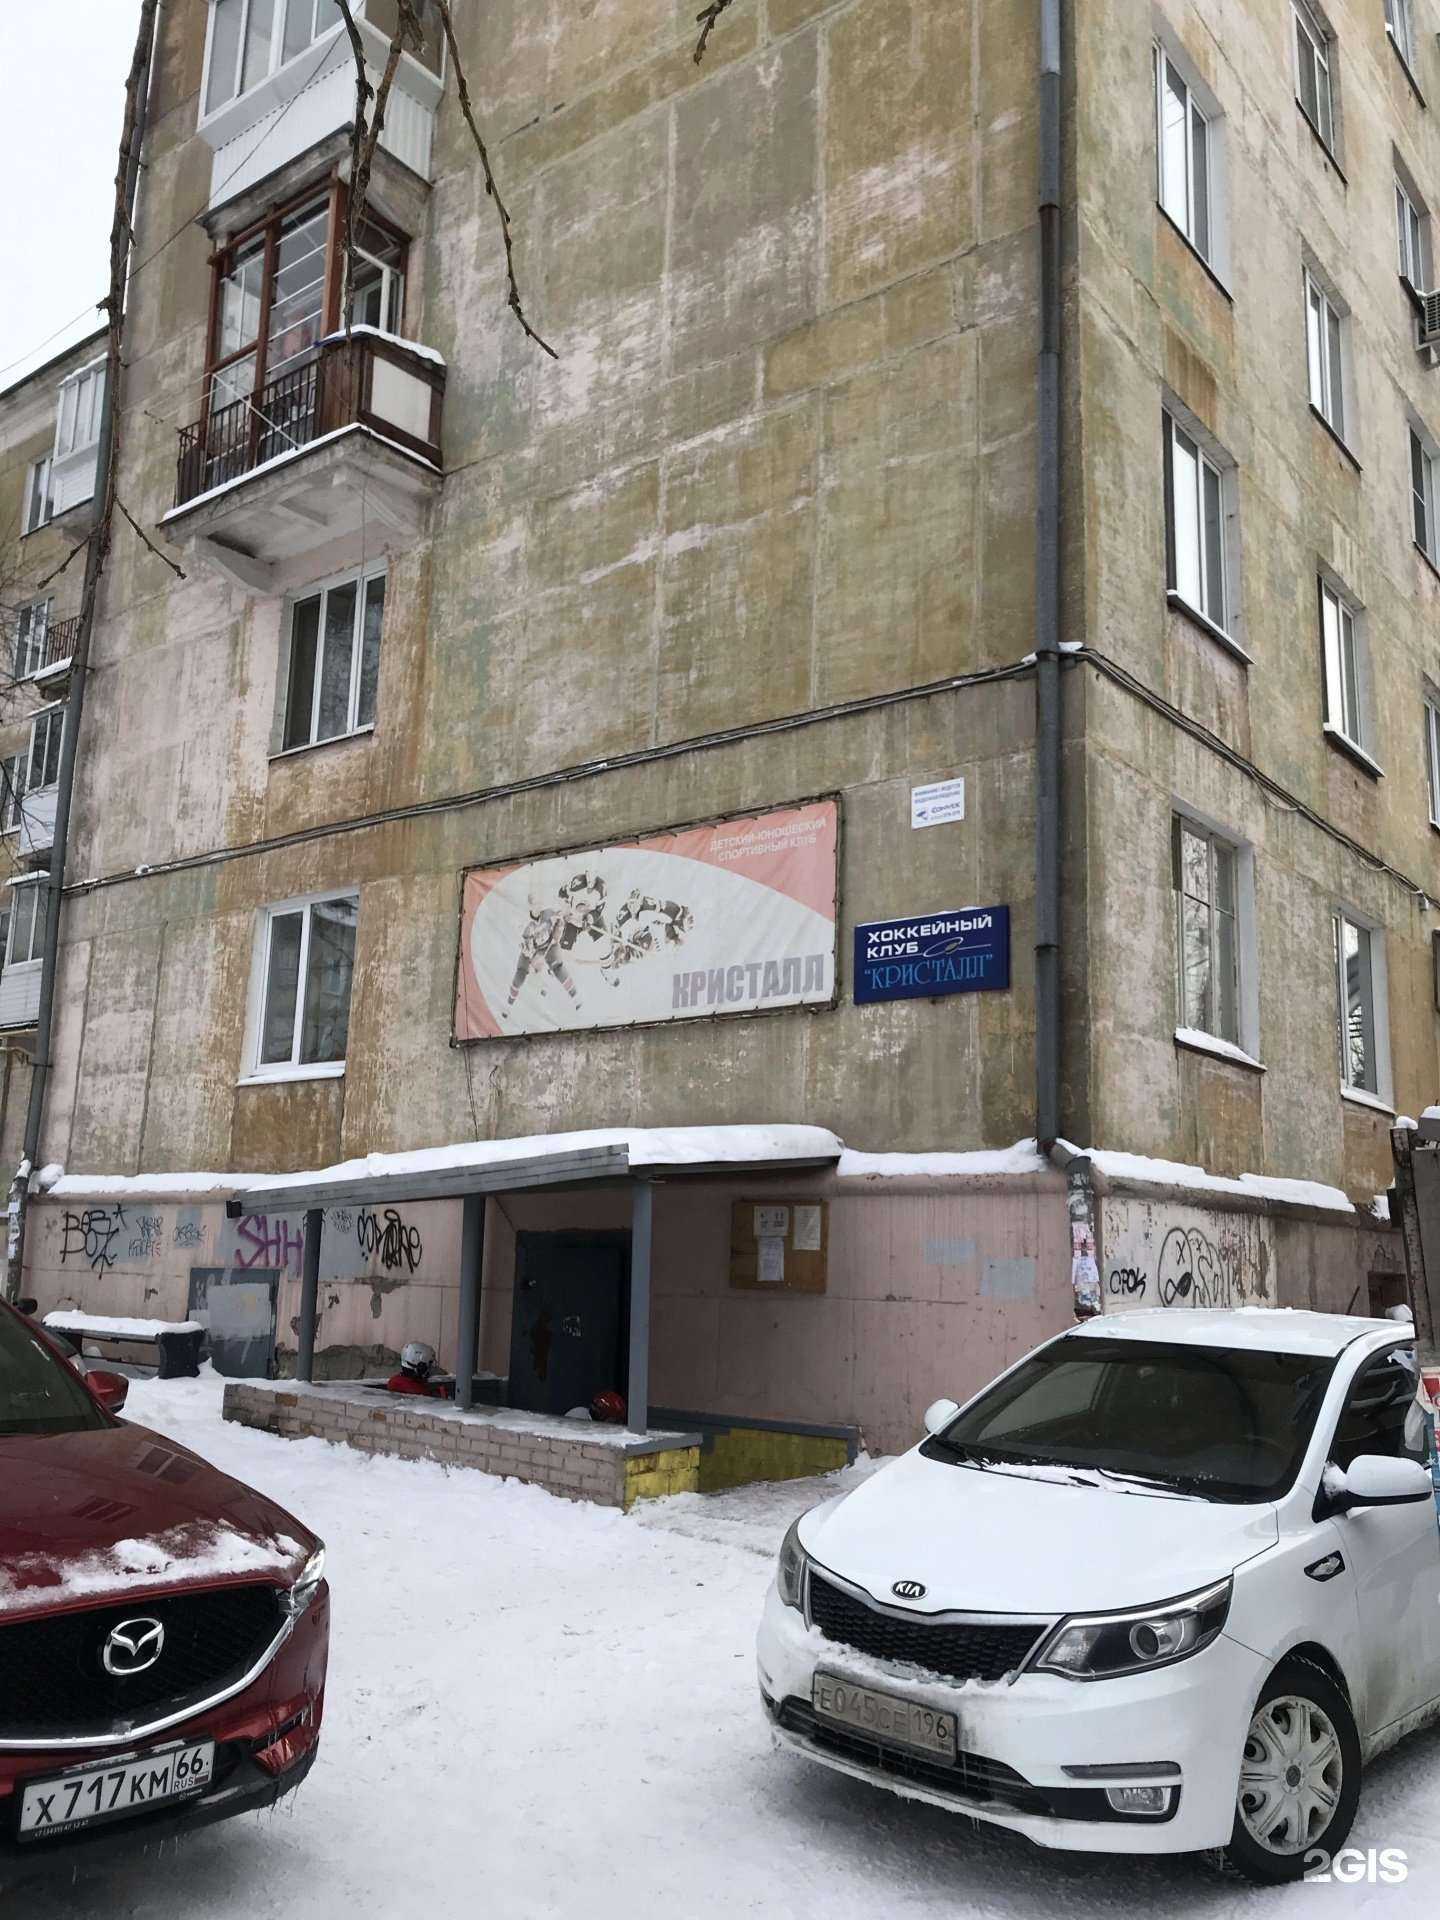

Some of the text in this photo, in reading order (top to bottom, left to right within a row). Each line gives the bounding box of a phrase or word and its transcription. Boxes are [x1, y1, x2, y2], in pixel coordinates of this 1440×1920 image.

[867, 914, 993, 944] ХОККЕЙНЫЙ
[866, 941, 919, 959] КЛУБ
[672, 954, 825, 1009] КРИСТАЛЛ
[895, 1582, 921, 1597] KIA
[913, 1709, 948, 1739] 196
[35, 1748, 204, 1826] Х717КМ 66
[173, 1776, 194, 1791] RUS
